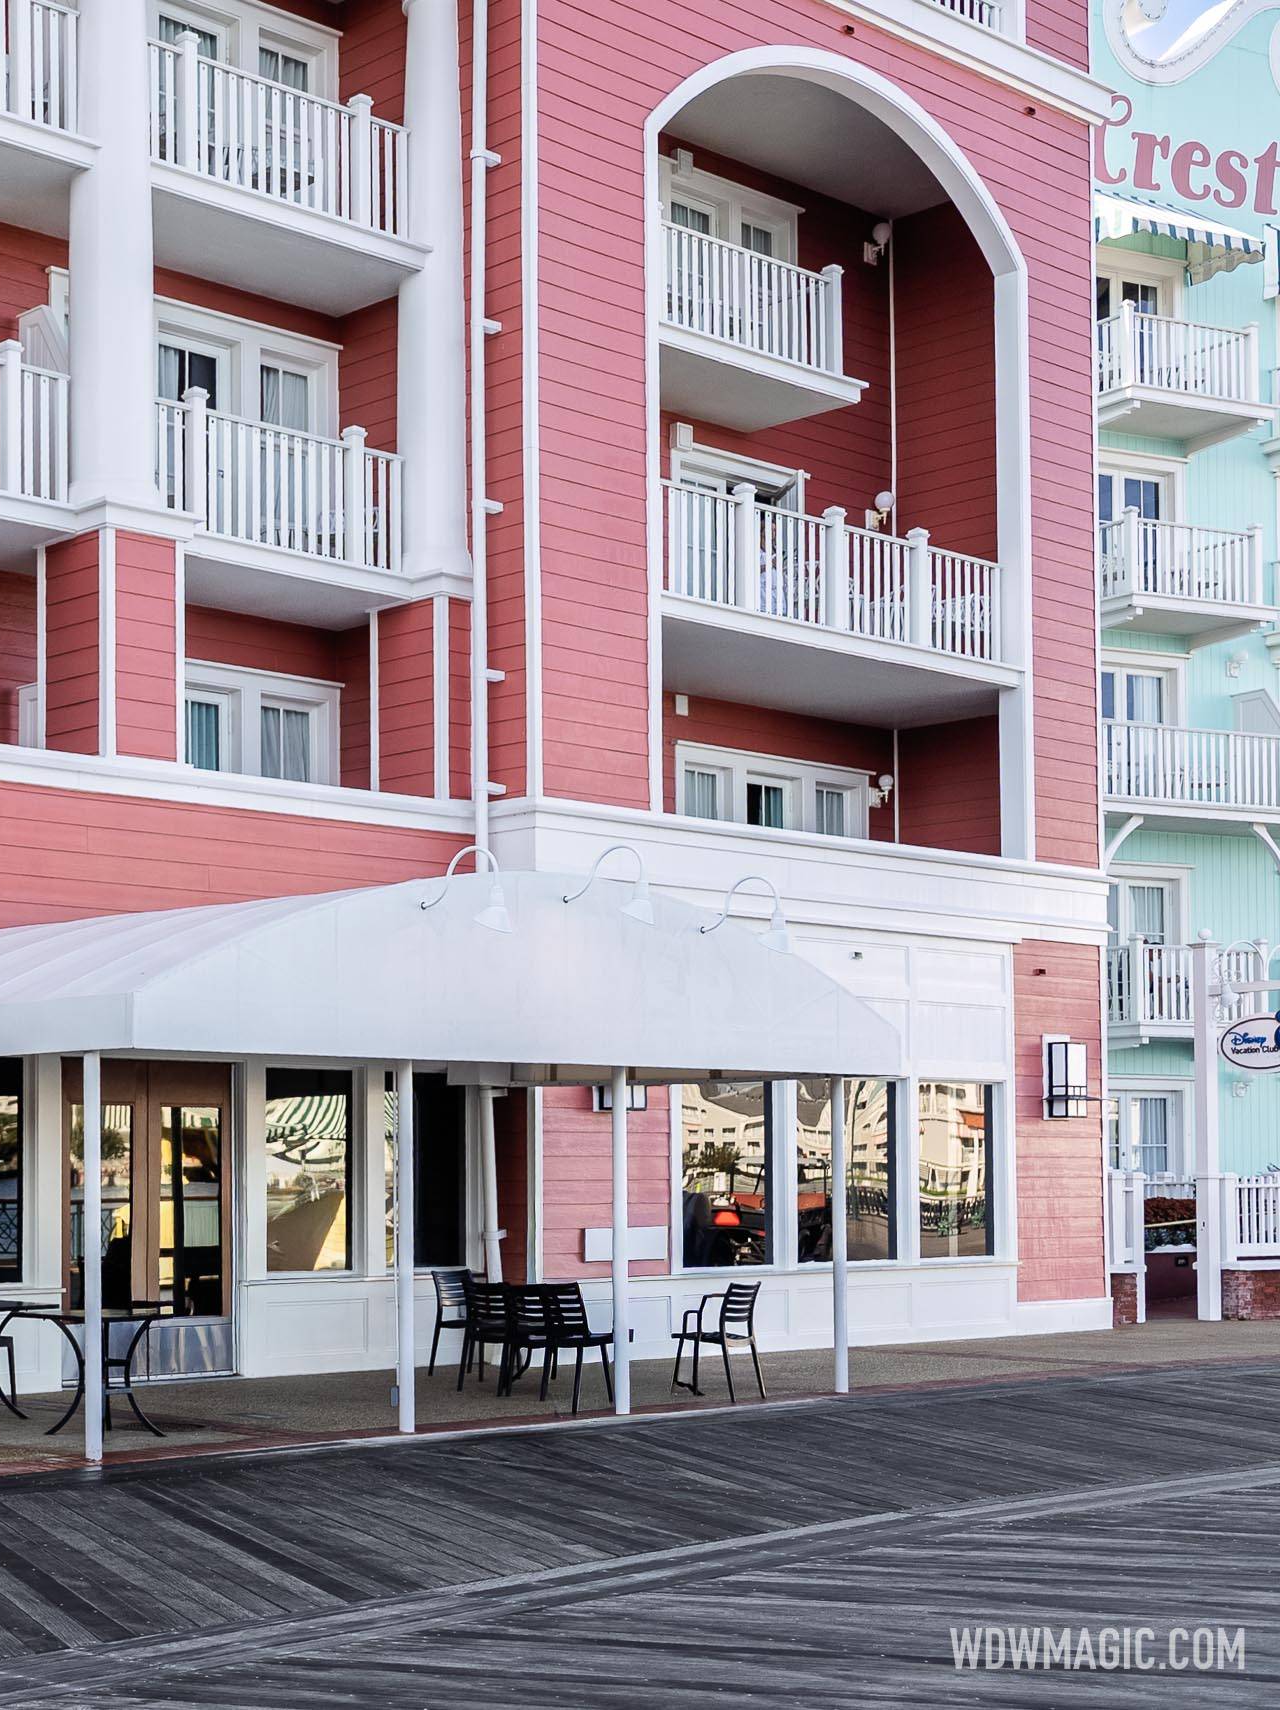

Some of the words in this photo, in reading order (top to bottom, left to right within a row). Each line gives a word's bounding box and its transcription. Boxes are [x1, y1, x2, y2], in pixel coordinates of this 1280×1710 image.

[1228, 1031, 1267, 1048] Disney
[1231, 1046, 1260, 1055] Vacation
[1262, 1045, 1279, 1053] Club
